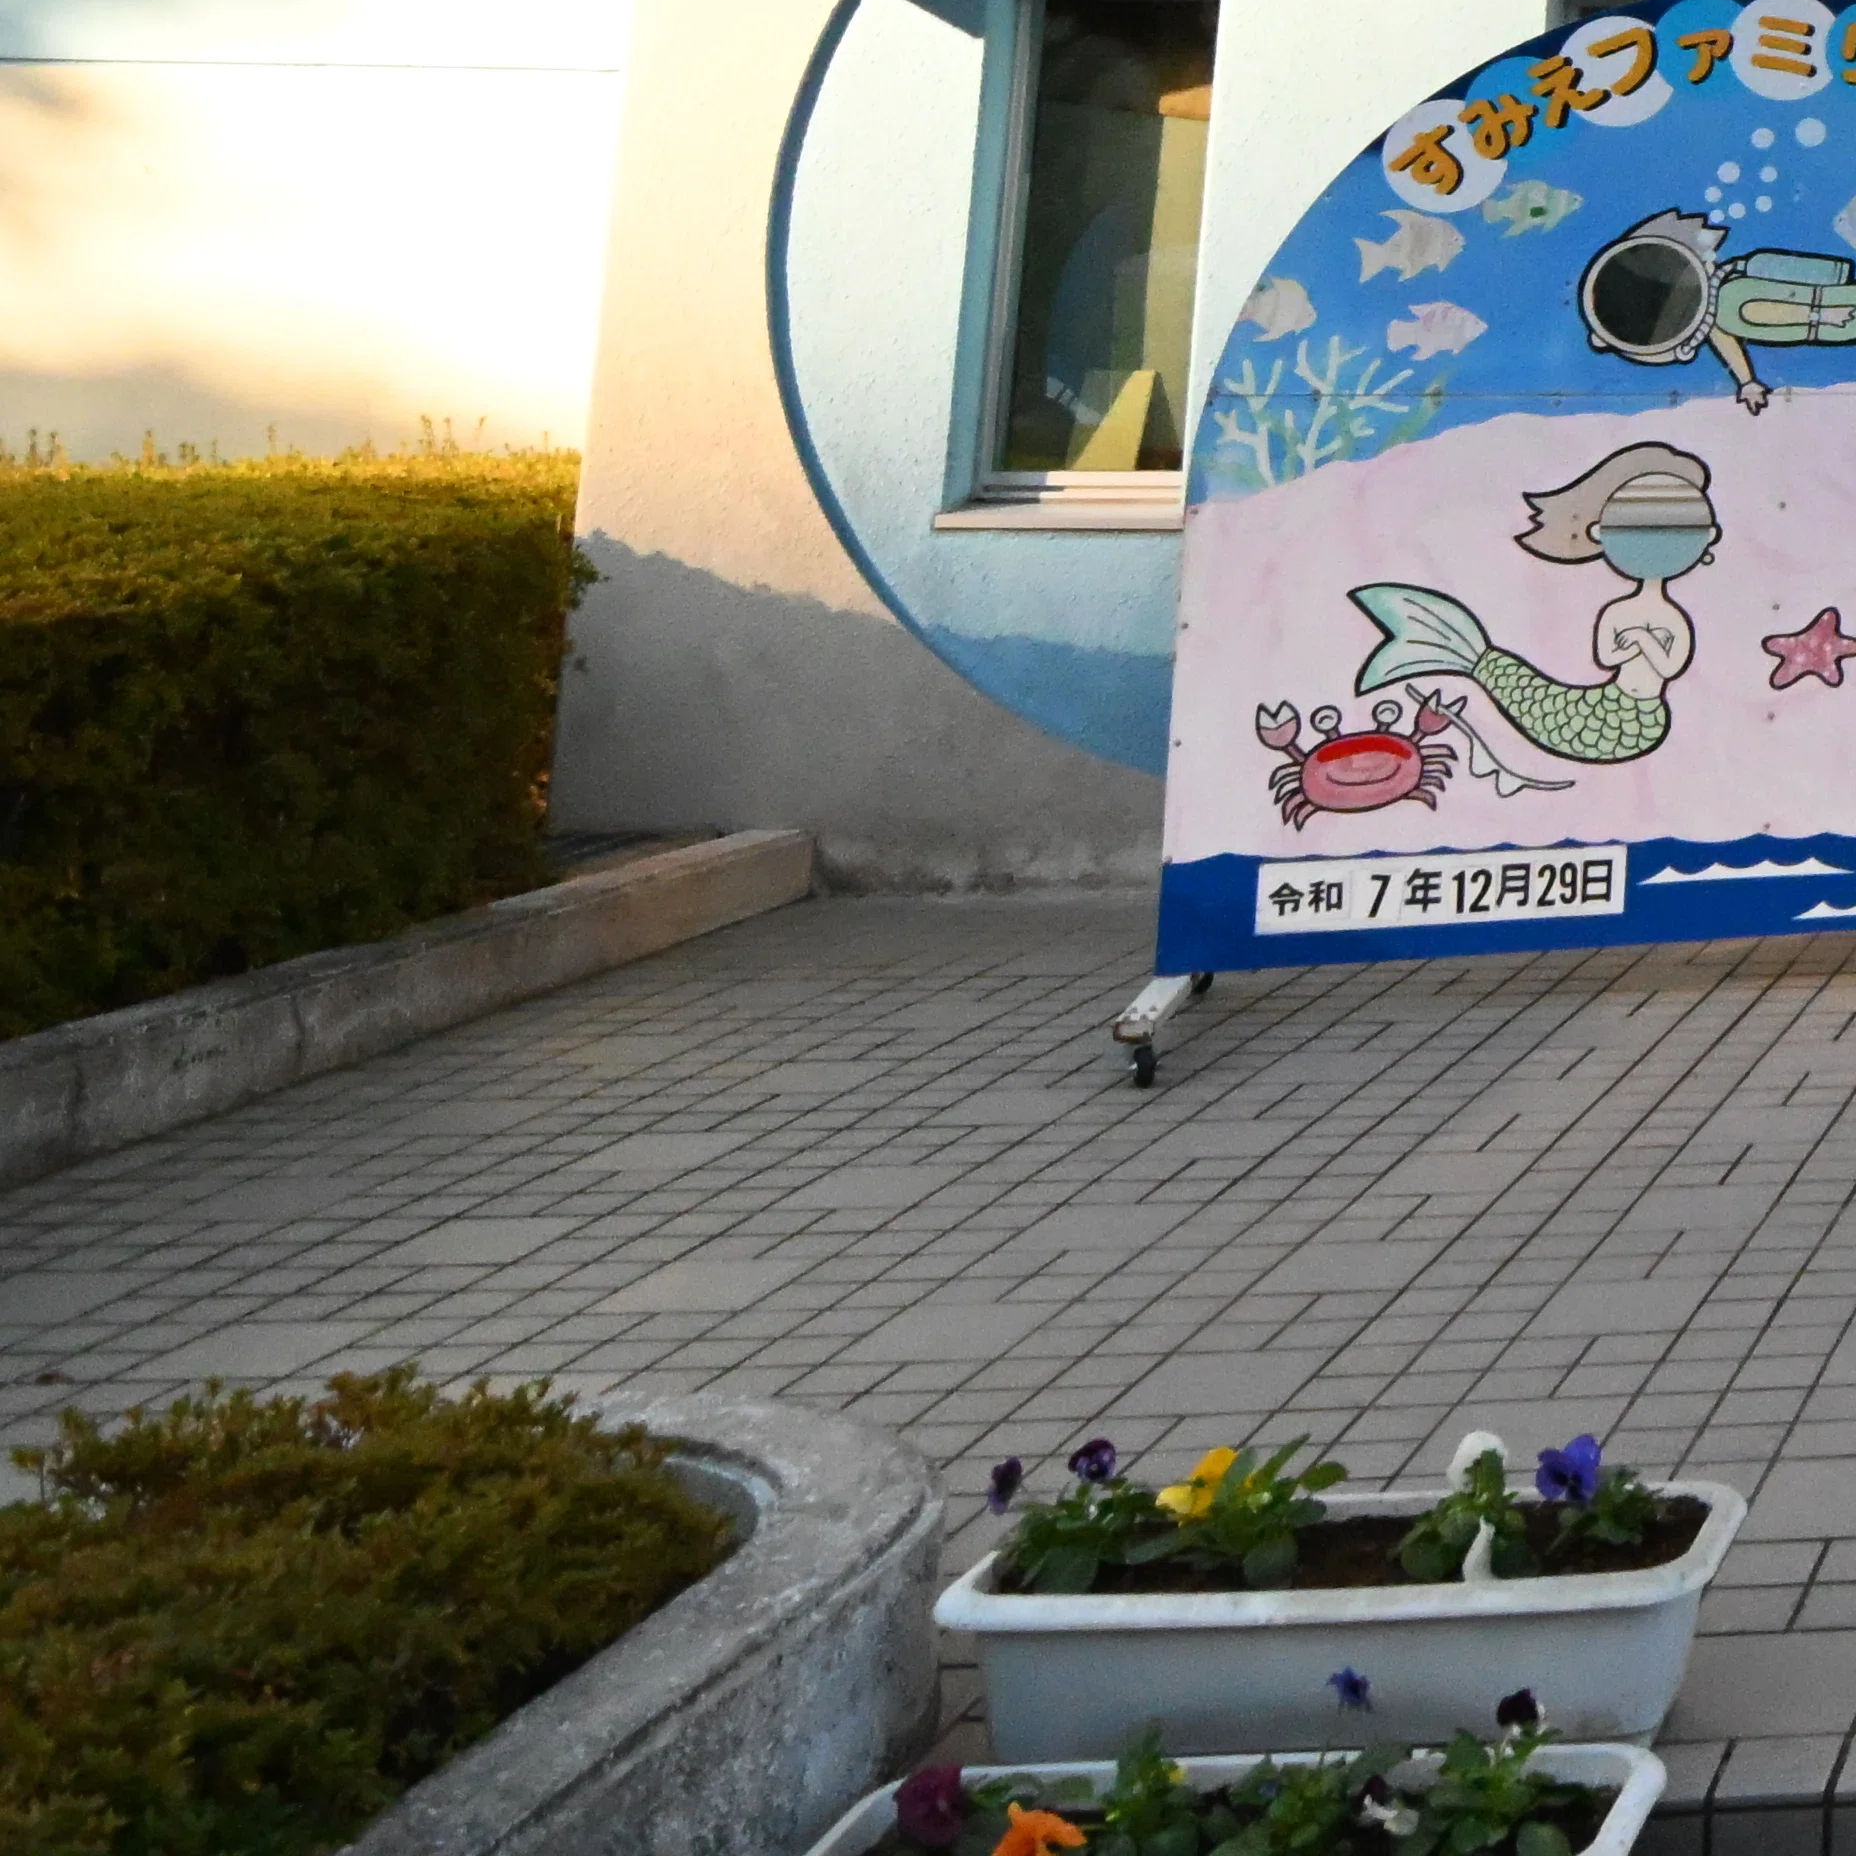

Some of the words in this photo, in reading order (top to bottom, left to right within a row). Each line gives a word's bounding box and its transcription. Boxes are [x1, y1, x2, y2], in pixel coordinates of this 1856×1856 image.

[1267, 858, 1614, 919] 令和7年12月29日
